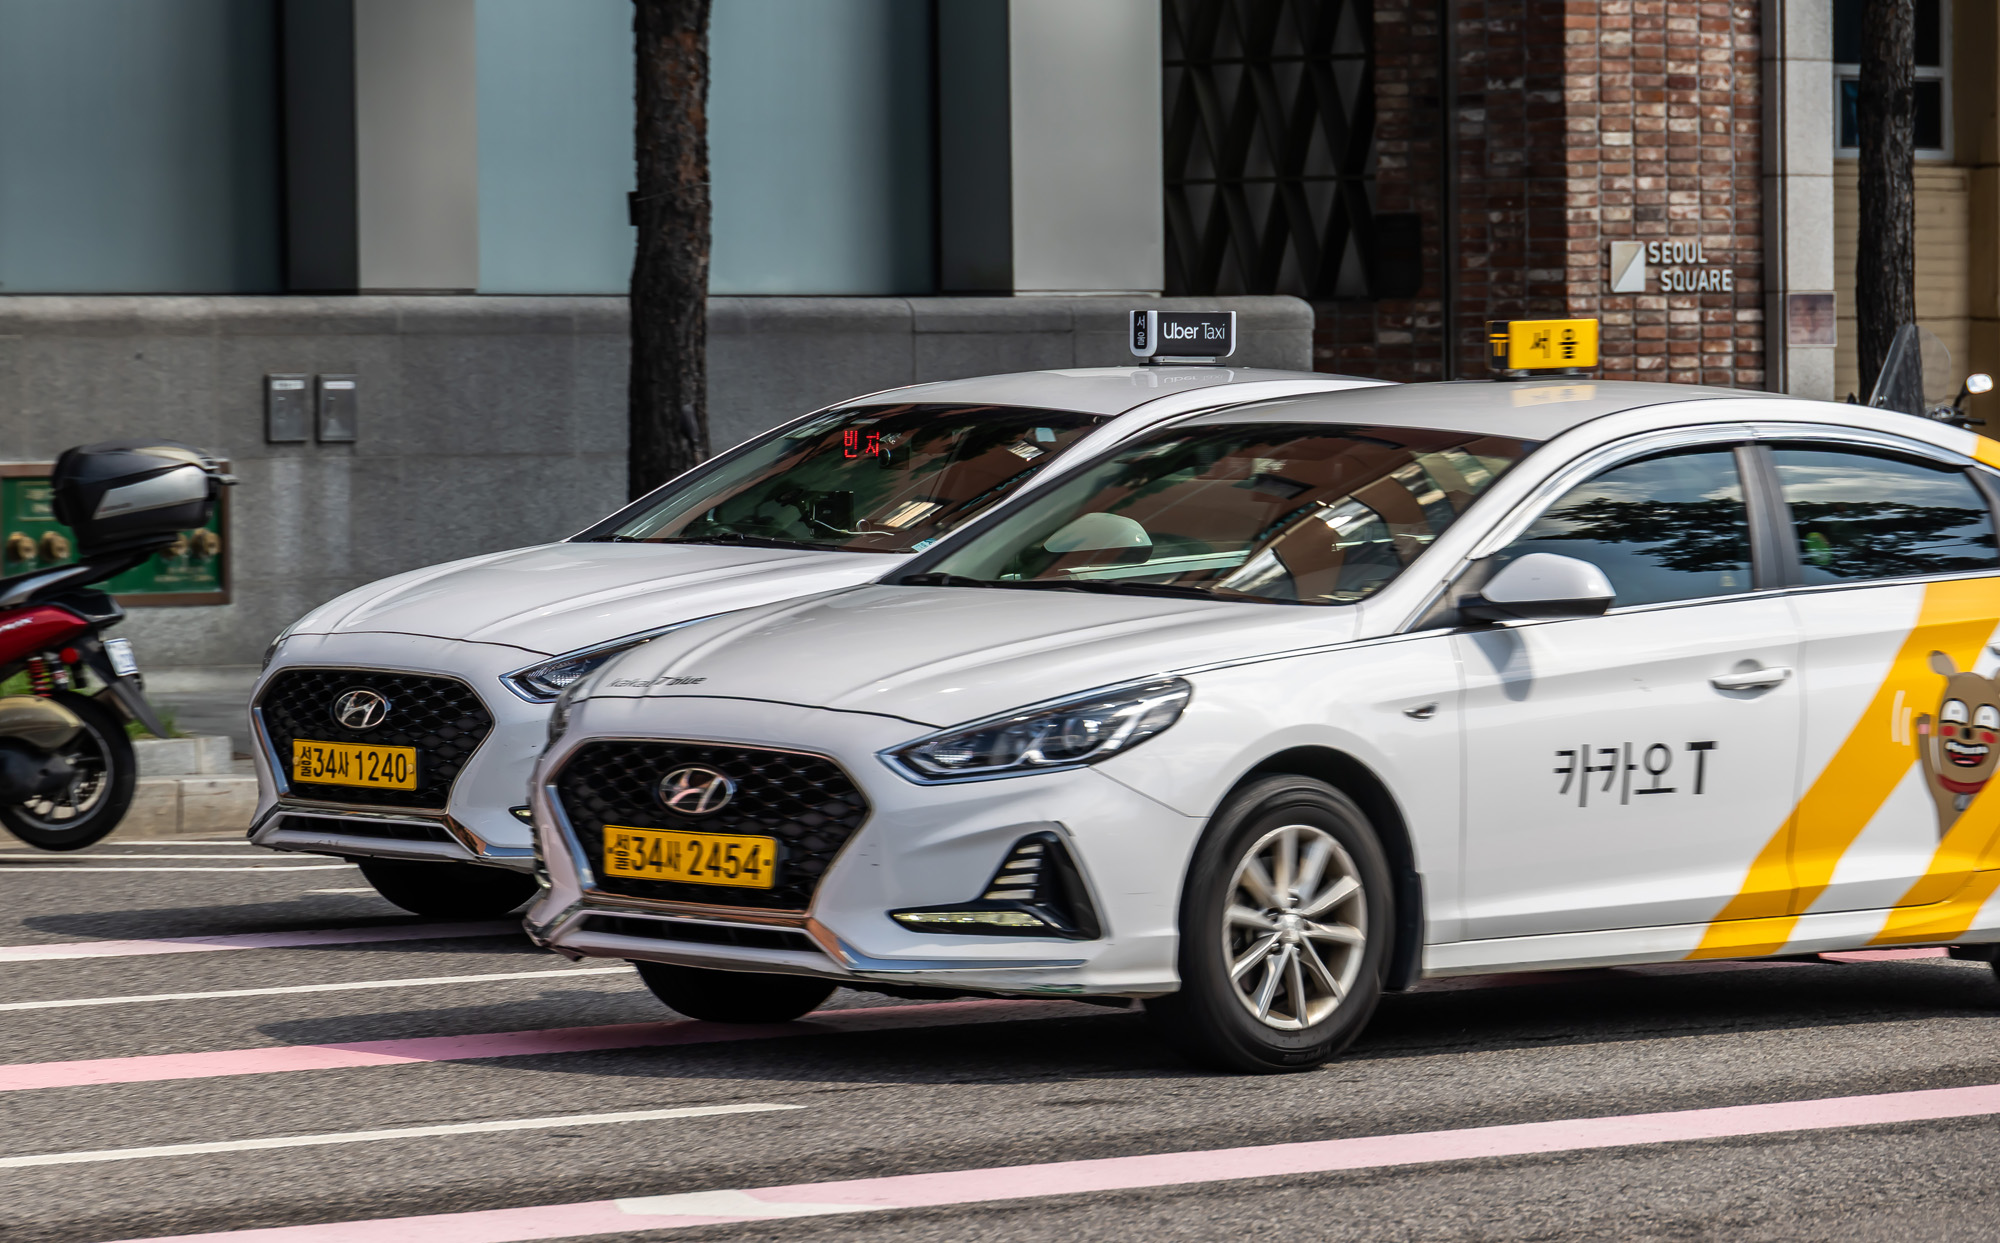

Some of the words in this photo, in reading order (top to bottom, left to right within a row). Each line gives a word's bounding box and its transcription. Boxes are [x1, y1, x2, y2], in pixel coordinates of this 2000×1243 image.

[1647, 241, 1708, 264] SEOUL
[1660, 268, 1734, 293] SQUARE
[1136, 315, 1146, 346] 서울
[1163, 322, 1199, 340] Uber
[1201, 322, 1226, 340] Taxi
[1529, 328, 1579, 360] 서울
[300, 746, 312, 777] 서울
[355, 751, 407, 783] 1240
[1553, 742, 1678, 808] 카카오
[1685, 741, 1720, 795] T
[687, 840, 761, 880] 2454
